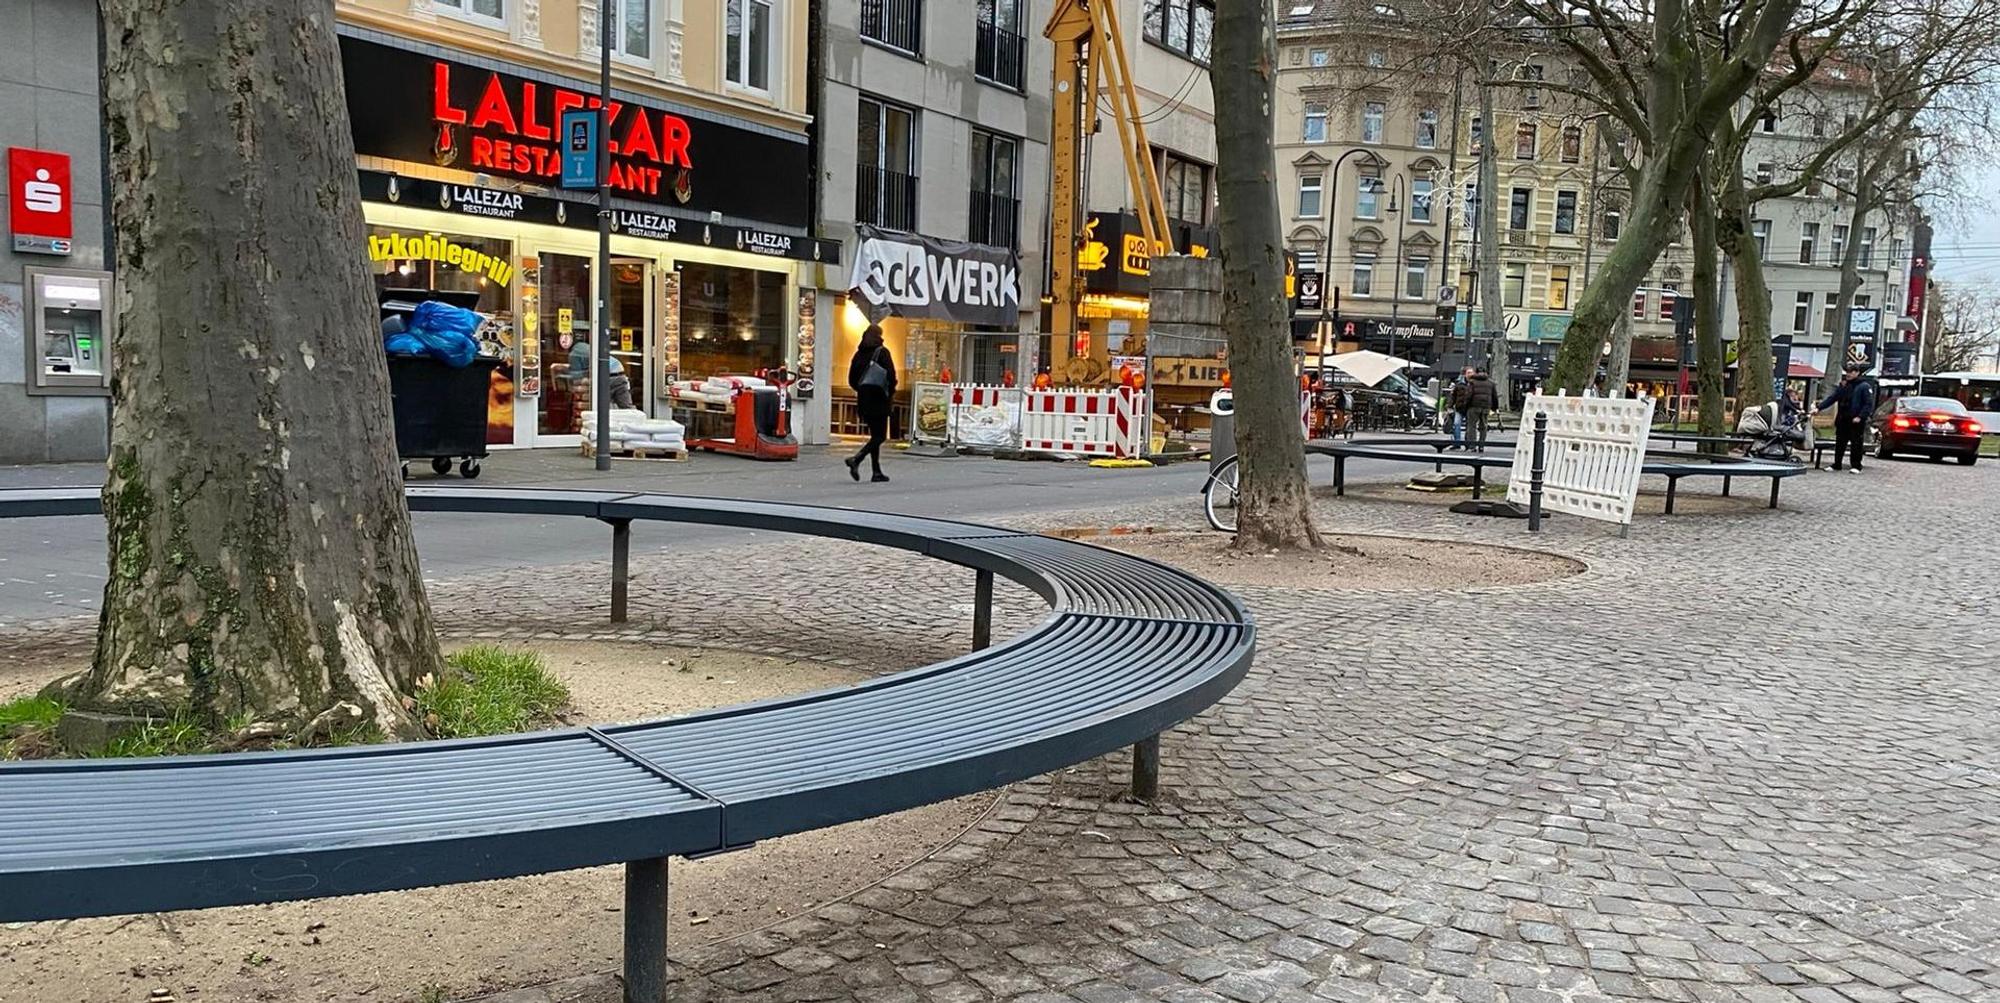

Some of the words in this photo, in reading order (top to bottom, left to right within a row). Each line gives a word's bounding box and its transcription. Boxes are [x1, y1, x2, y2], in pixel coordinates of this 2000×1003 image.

[471, 135, 662, 196] RESTAANT
[453, 185, 524, 211] LALEZAR
[462, 203, 515, 219] RESTAURANT
[620, 210, 677, 233] LALEZAR
[627, 226, 670, 240] RESTAURANT
[744, 230, 791, 250] LALEZAR
[368, 232, 513, 288] lzkohlegrill
[750, 244, 786, 256] RESTAURANT
[1377, 322, 1434, 339] Strmpfhaus
